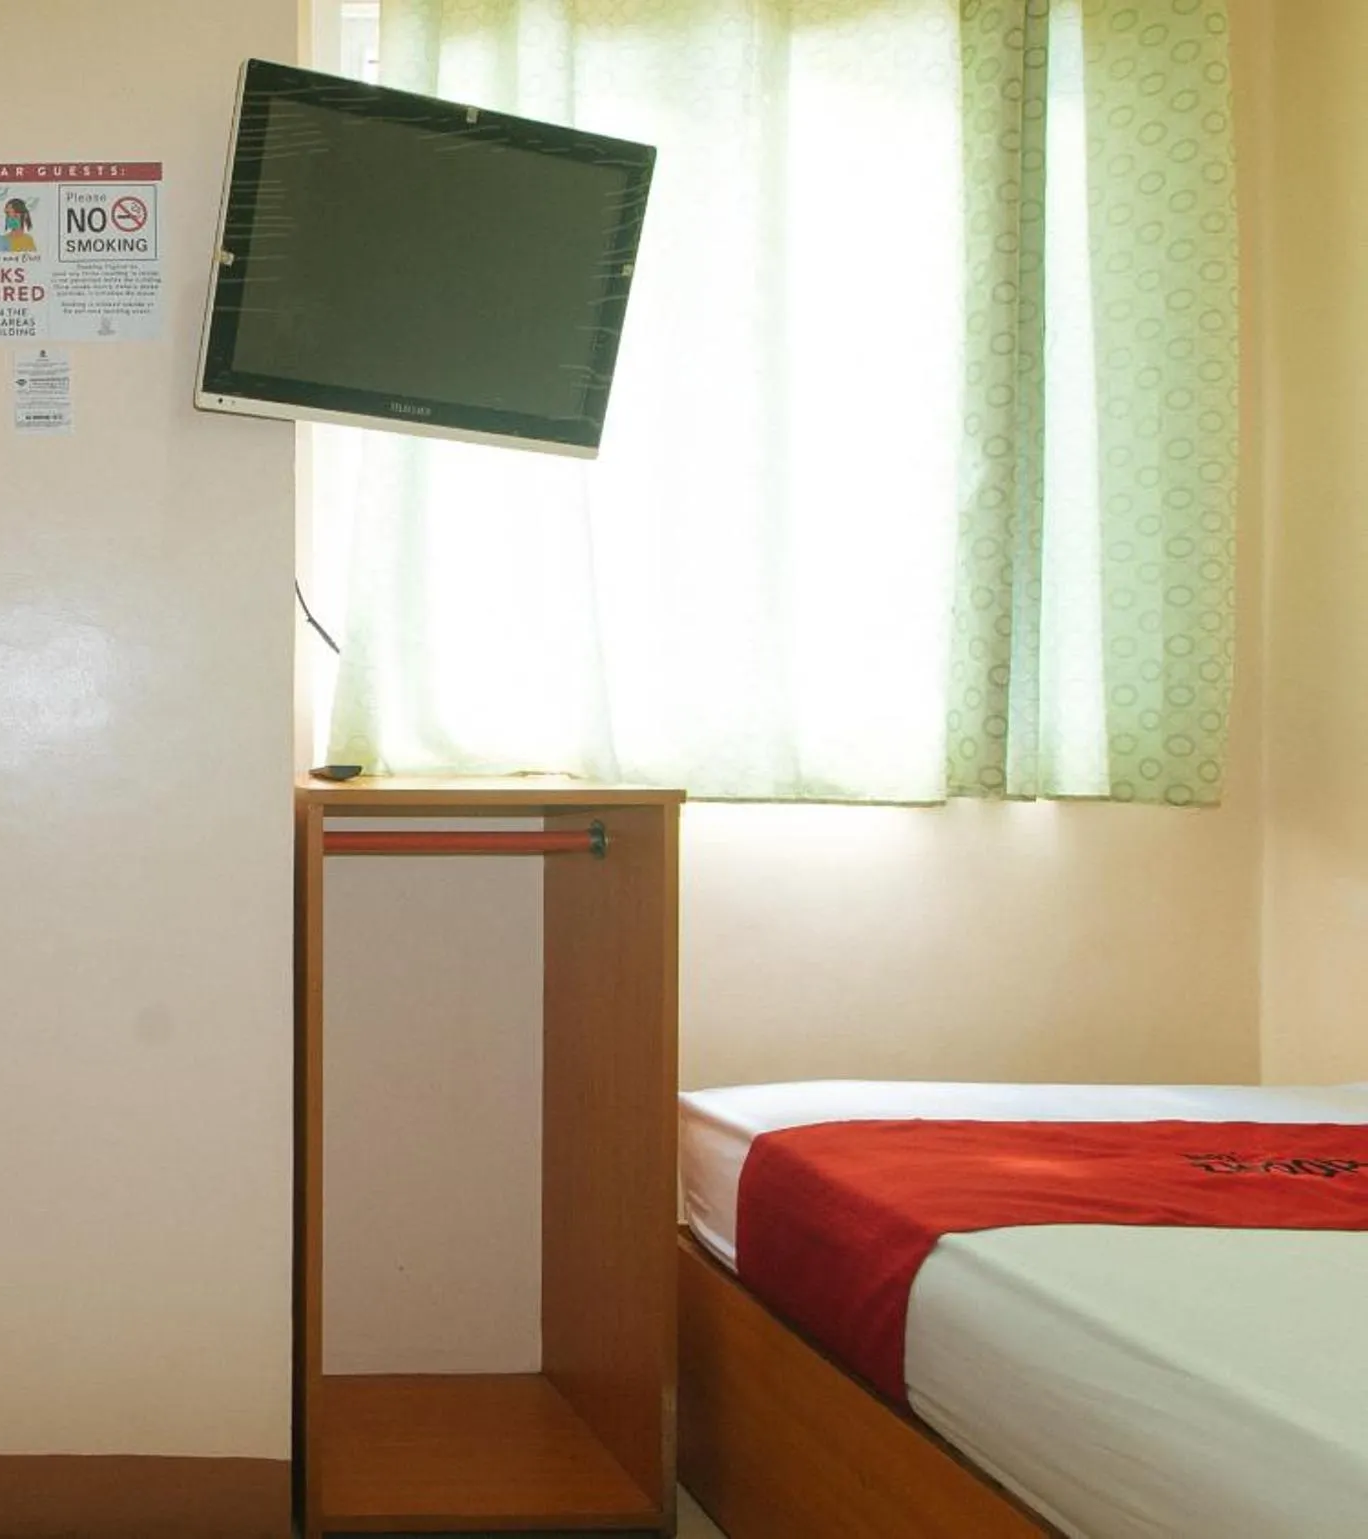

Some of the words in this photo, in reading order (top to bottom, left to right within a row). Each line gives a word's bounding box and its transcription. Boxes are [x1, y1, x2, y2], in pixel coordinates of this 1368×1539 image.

[37, 165, 127, 177] GUESTS:
[66, 192, 107, 203] Please
[66, 207, 107, 234] NO
[66, 238, 149, 253] SMOKING
[6, 307, 28, 317] THE
[0, 318, 36, 327] AREAS
